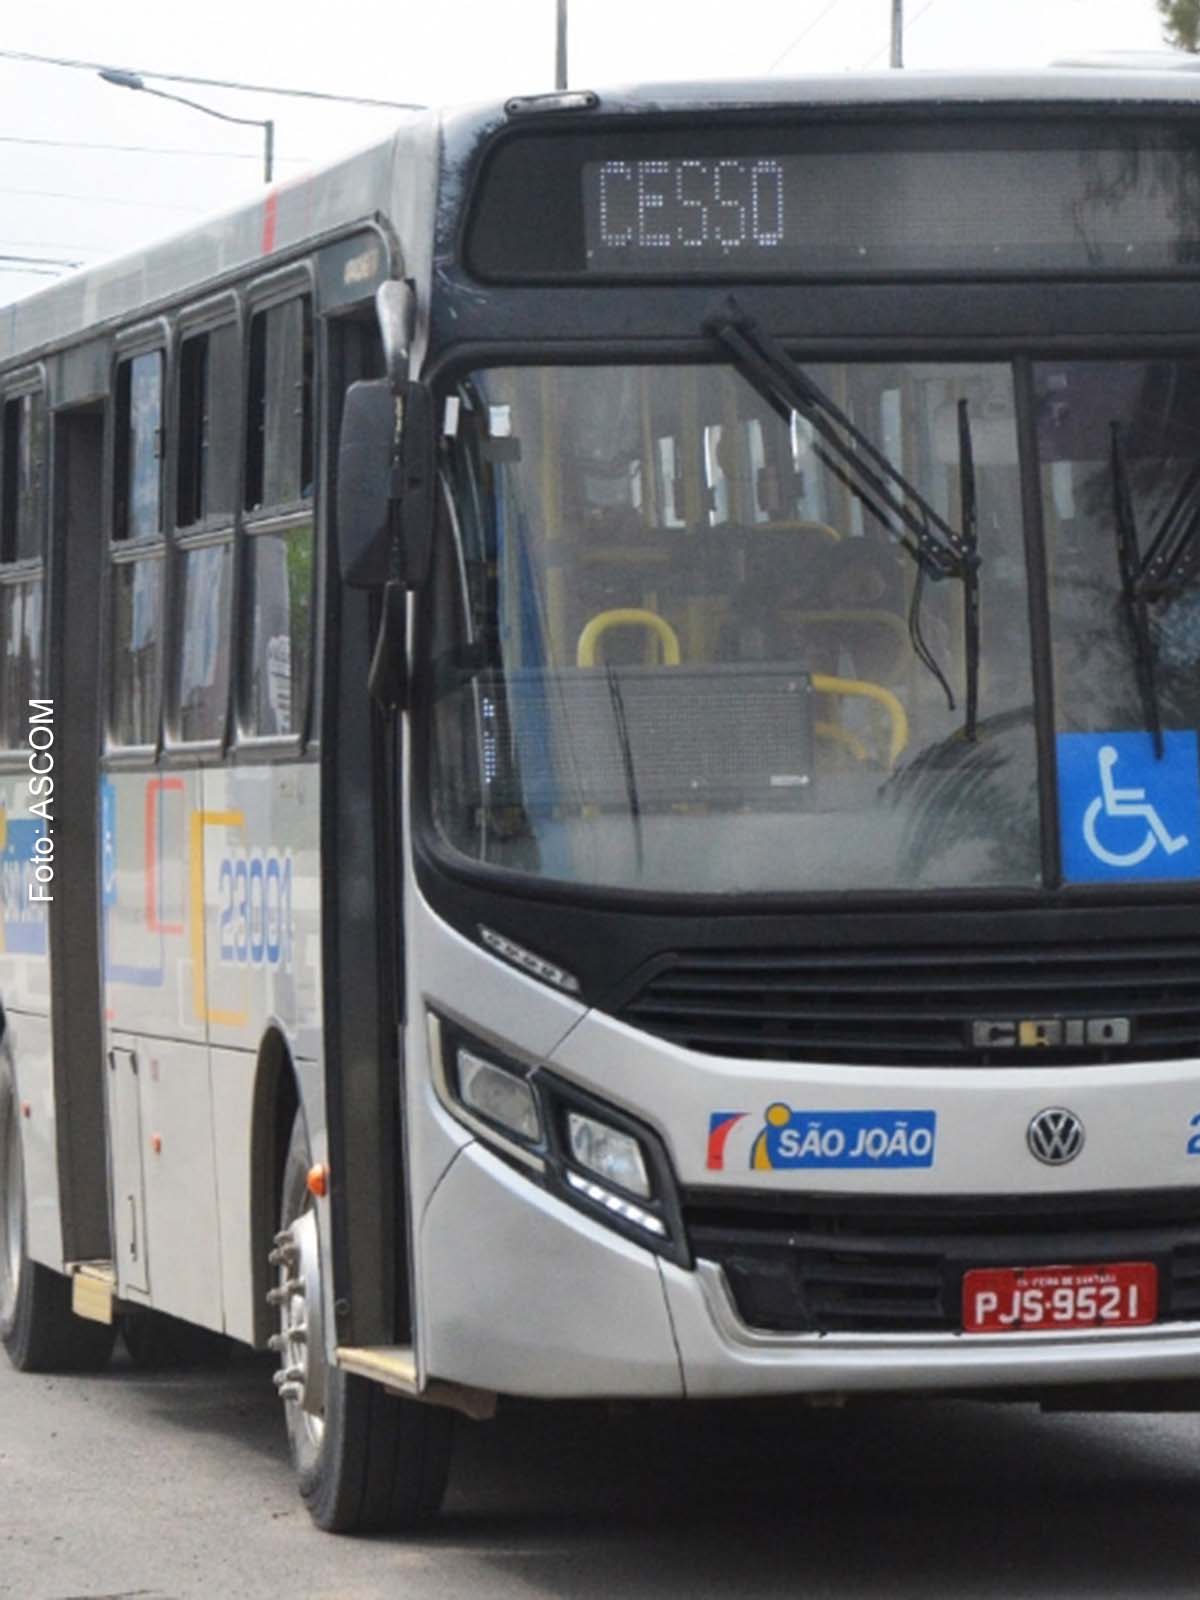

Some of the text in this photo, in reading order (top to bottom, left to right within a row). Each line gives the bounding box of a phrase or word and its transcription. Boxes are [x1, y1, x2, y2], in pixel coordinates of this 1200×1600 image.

[600, 161, 782, 245] CESSO
[219, 857, 293, 963] 23001
[778, 1121, 932, 1159] SÃO JOÃO
